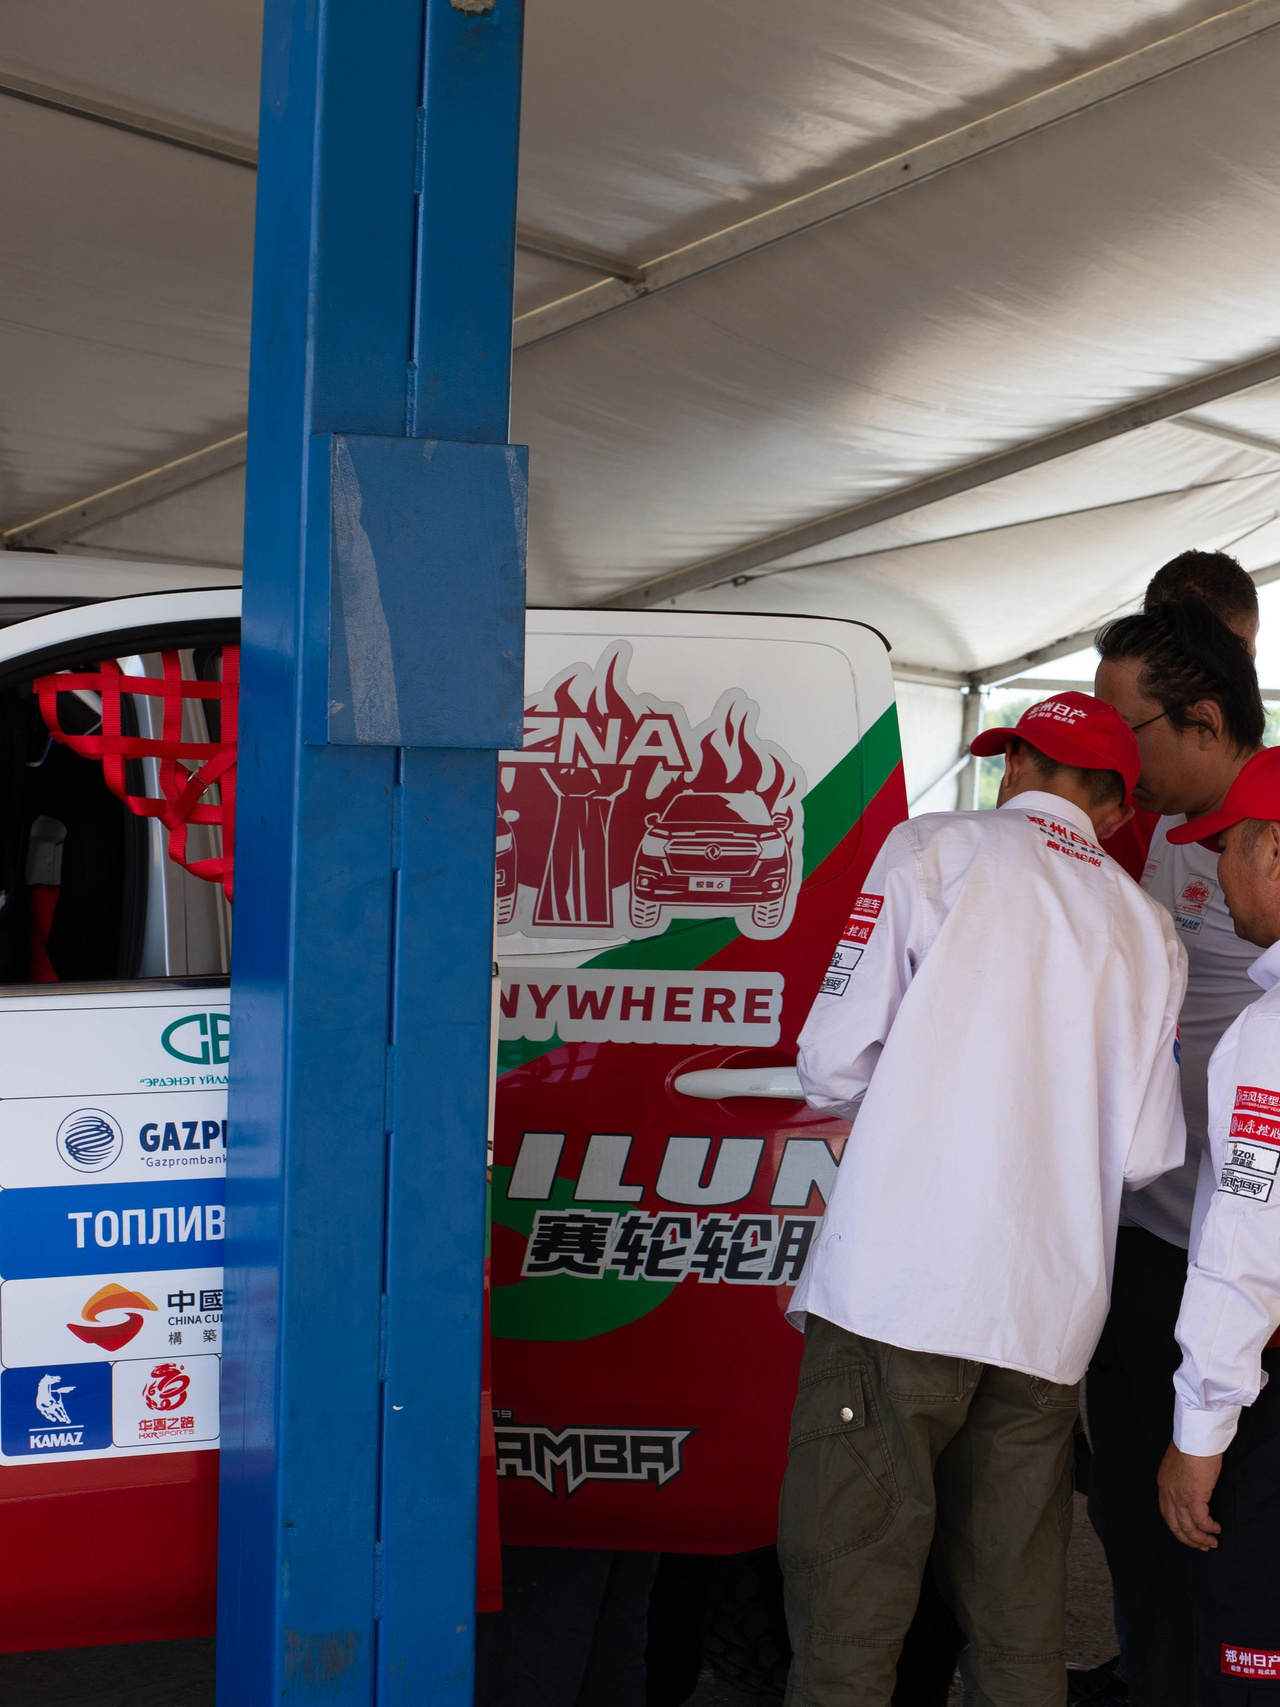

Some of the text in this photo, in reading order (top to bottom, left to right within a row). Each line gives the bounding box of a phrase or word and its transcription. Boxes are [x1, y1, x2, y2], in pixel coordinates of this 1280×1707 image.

[67, 1204, 226, 1249] ТОПЛИВ
[168, 1315, 202, 1326] CHINA
[29, 1431, 84, 1449] KAMAZ
